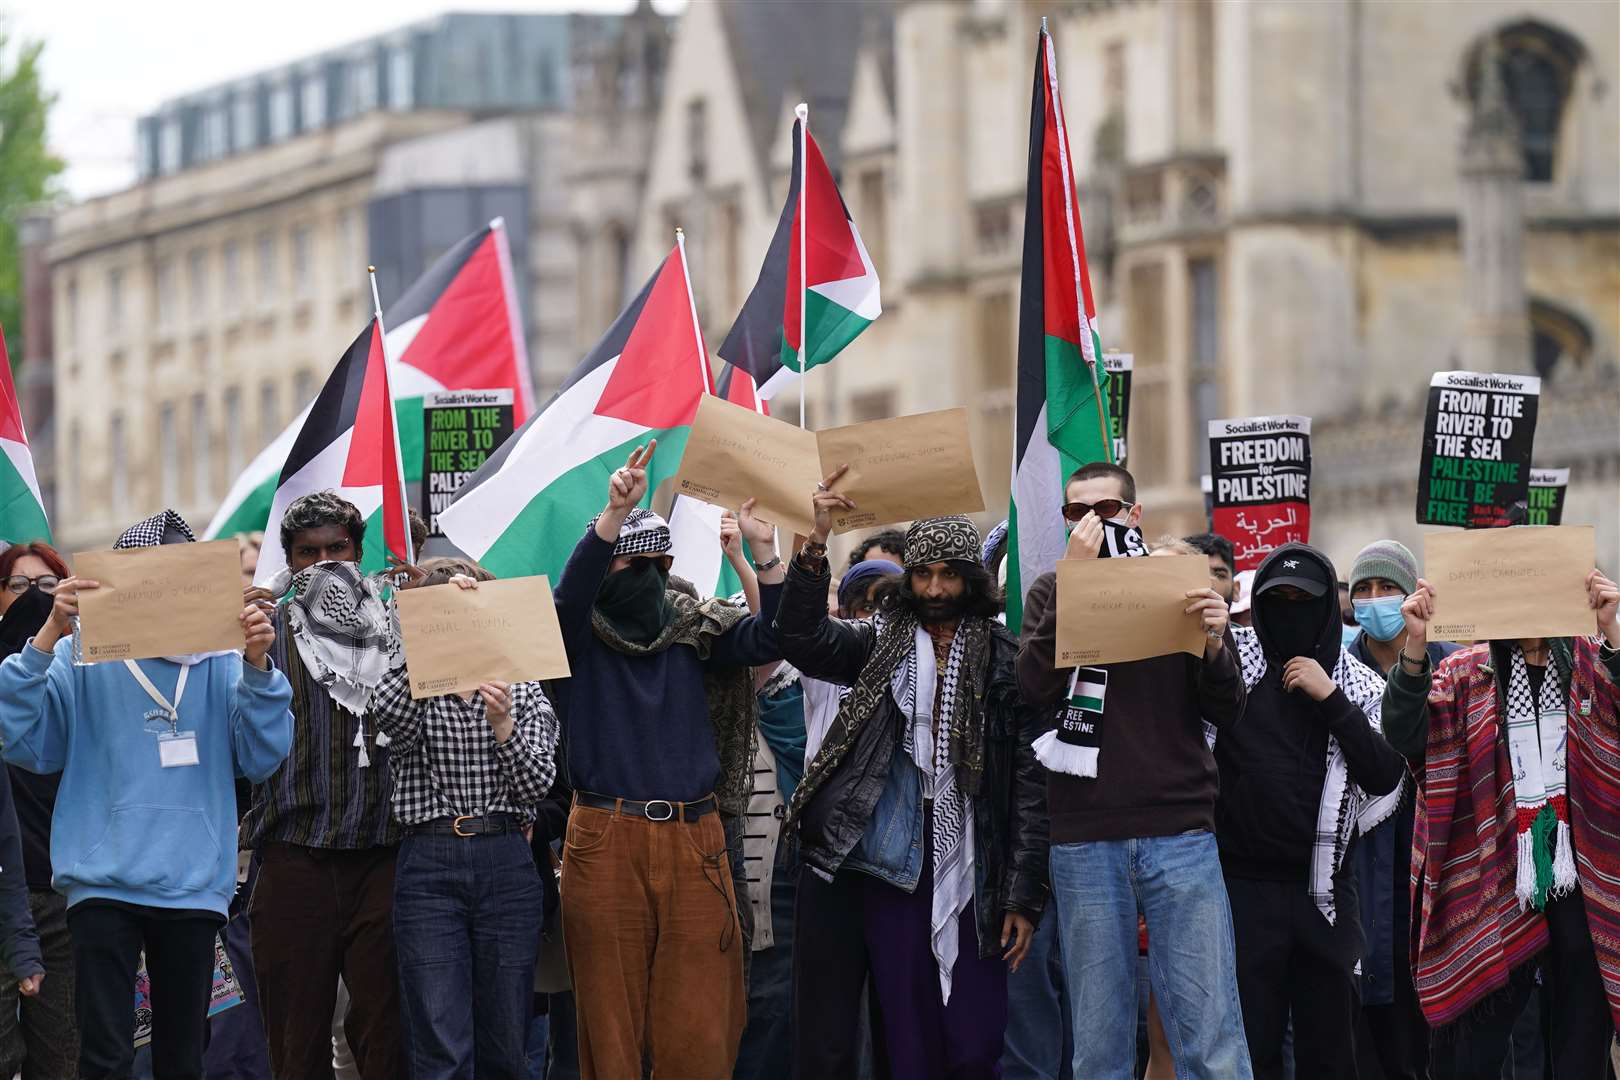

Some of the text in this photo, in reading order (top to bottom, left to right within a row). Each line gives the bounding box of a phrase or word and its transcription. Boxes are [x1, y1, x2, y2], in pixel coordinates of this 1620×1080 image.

[1447, 375, 1524, 391] Socialist Worker
[434, 393, 498, 405] Socialist Worker
[1438, 390, 1524, 418] FROM THE
[431, 408, 501, 430] FROM THE
[1226, 419, 1300, 434] Socialist Worker
[1436, 412, 1513, 440] RIVER TO
[430, 429, 493, 451] RIVER TO
[1220, 436, 1304, 466] FREEDOM
[1434, 434, 1502, 461] THE SEA
[430, 452, 455, 471] THE
[1259, 463, 1274, 475] for
[1430, 456, 1520, 483] PALESTINE
[1218, 473, 1307, 503] PALESTINE
[1529, 474, 1557, 483] orker
[1429, 479, 1496, 504] WILL BE
[1528, 488, 1558, 507] THE
[1236, 507, 1296, 534] الحرية
[1427, 500, 1467, 524] FREE
[1528, 509, 1548, 526] TO
[1066, 709, 1083, 721] REE
[1063, 720, 1095, 734] ESTINE
